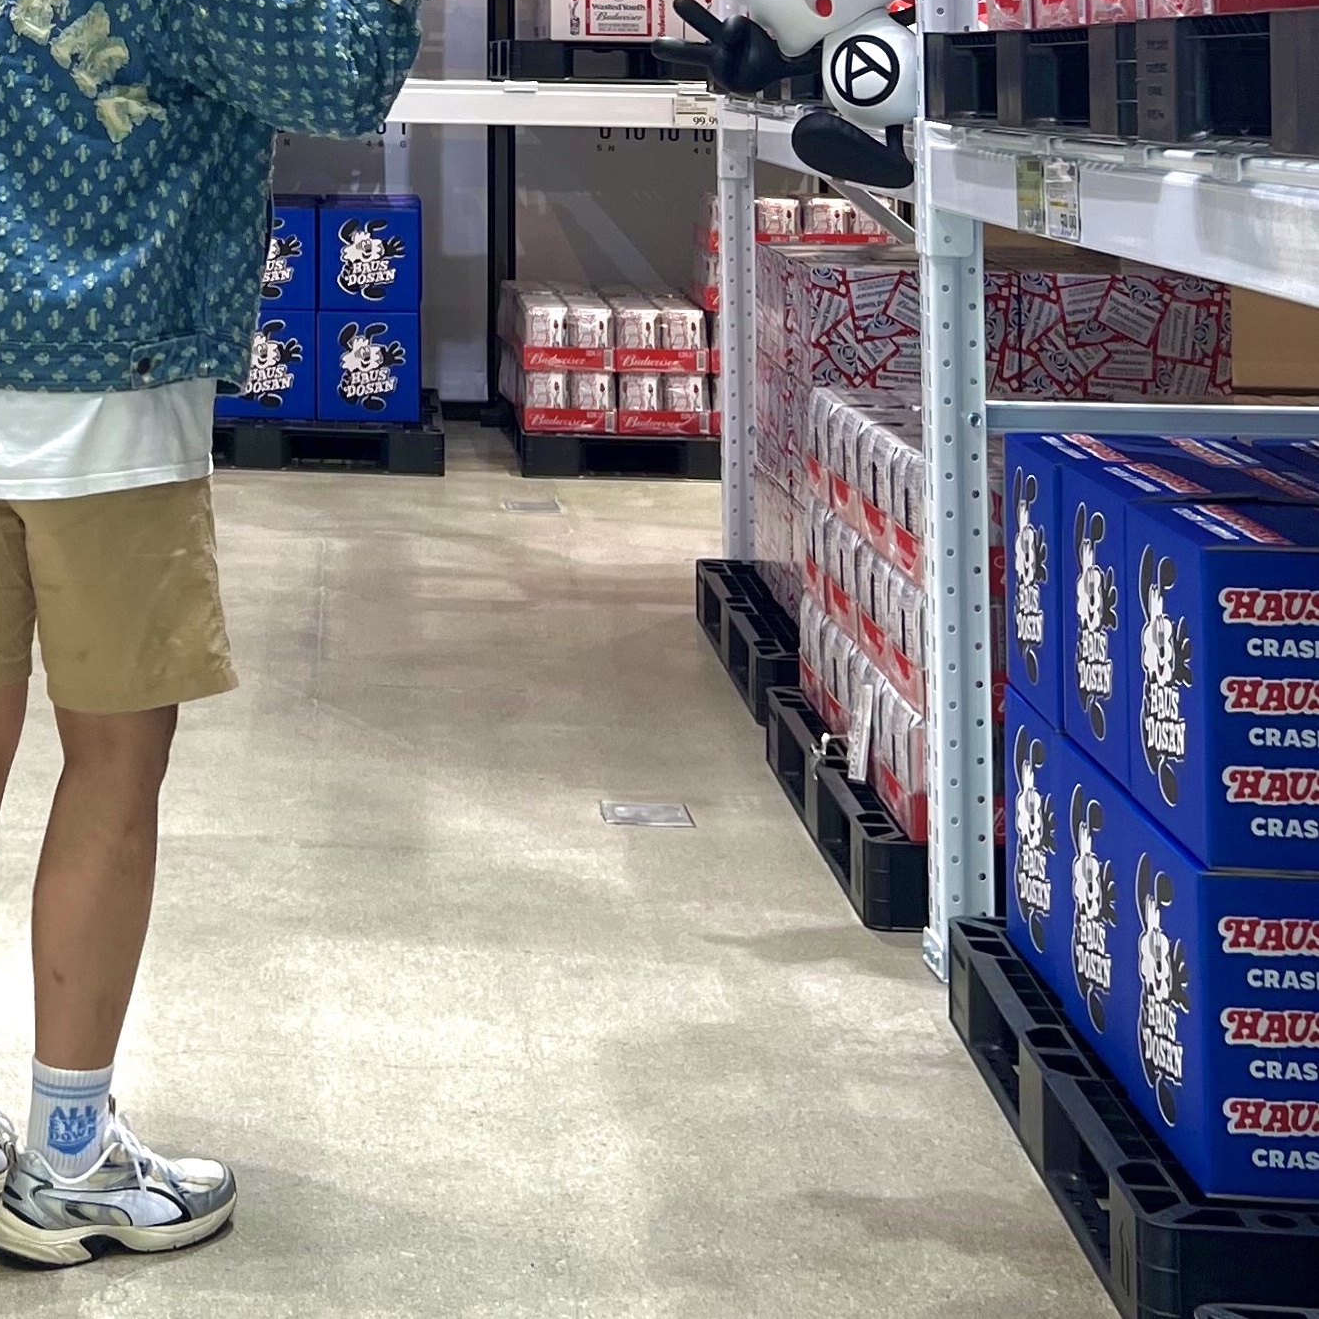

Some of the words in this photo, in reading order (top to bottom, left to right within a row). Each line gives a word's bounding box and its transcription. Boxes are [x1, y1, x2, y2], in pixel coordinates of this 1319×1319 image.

[345, 268, 396, 287] DOSAN
[353, 260, 389, 274] HAUS
[344, 378, 396, 398] DOSAN
[351, 369, 388, 383] HAUS
[1080, 630, 1108, 663] HAUS
[1078, 660, 1113, 697] DOSAN
[1149, 682, 1180, 721] HAUS
[1145, 716, 1186, 756] DOSAN
[1022, 847, 1046, 880] HAUS
[1018, 874, 1052, 911] DOSAN
[1080, 914, 1106, 954] HAUS
[1076, 945, 1112, 988] DOSAN
[1147, 995, 1178, 1040] HAUS
[1142, 1028, 1183, 1079] DOSAN
